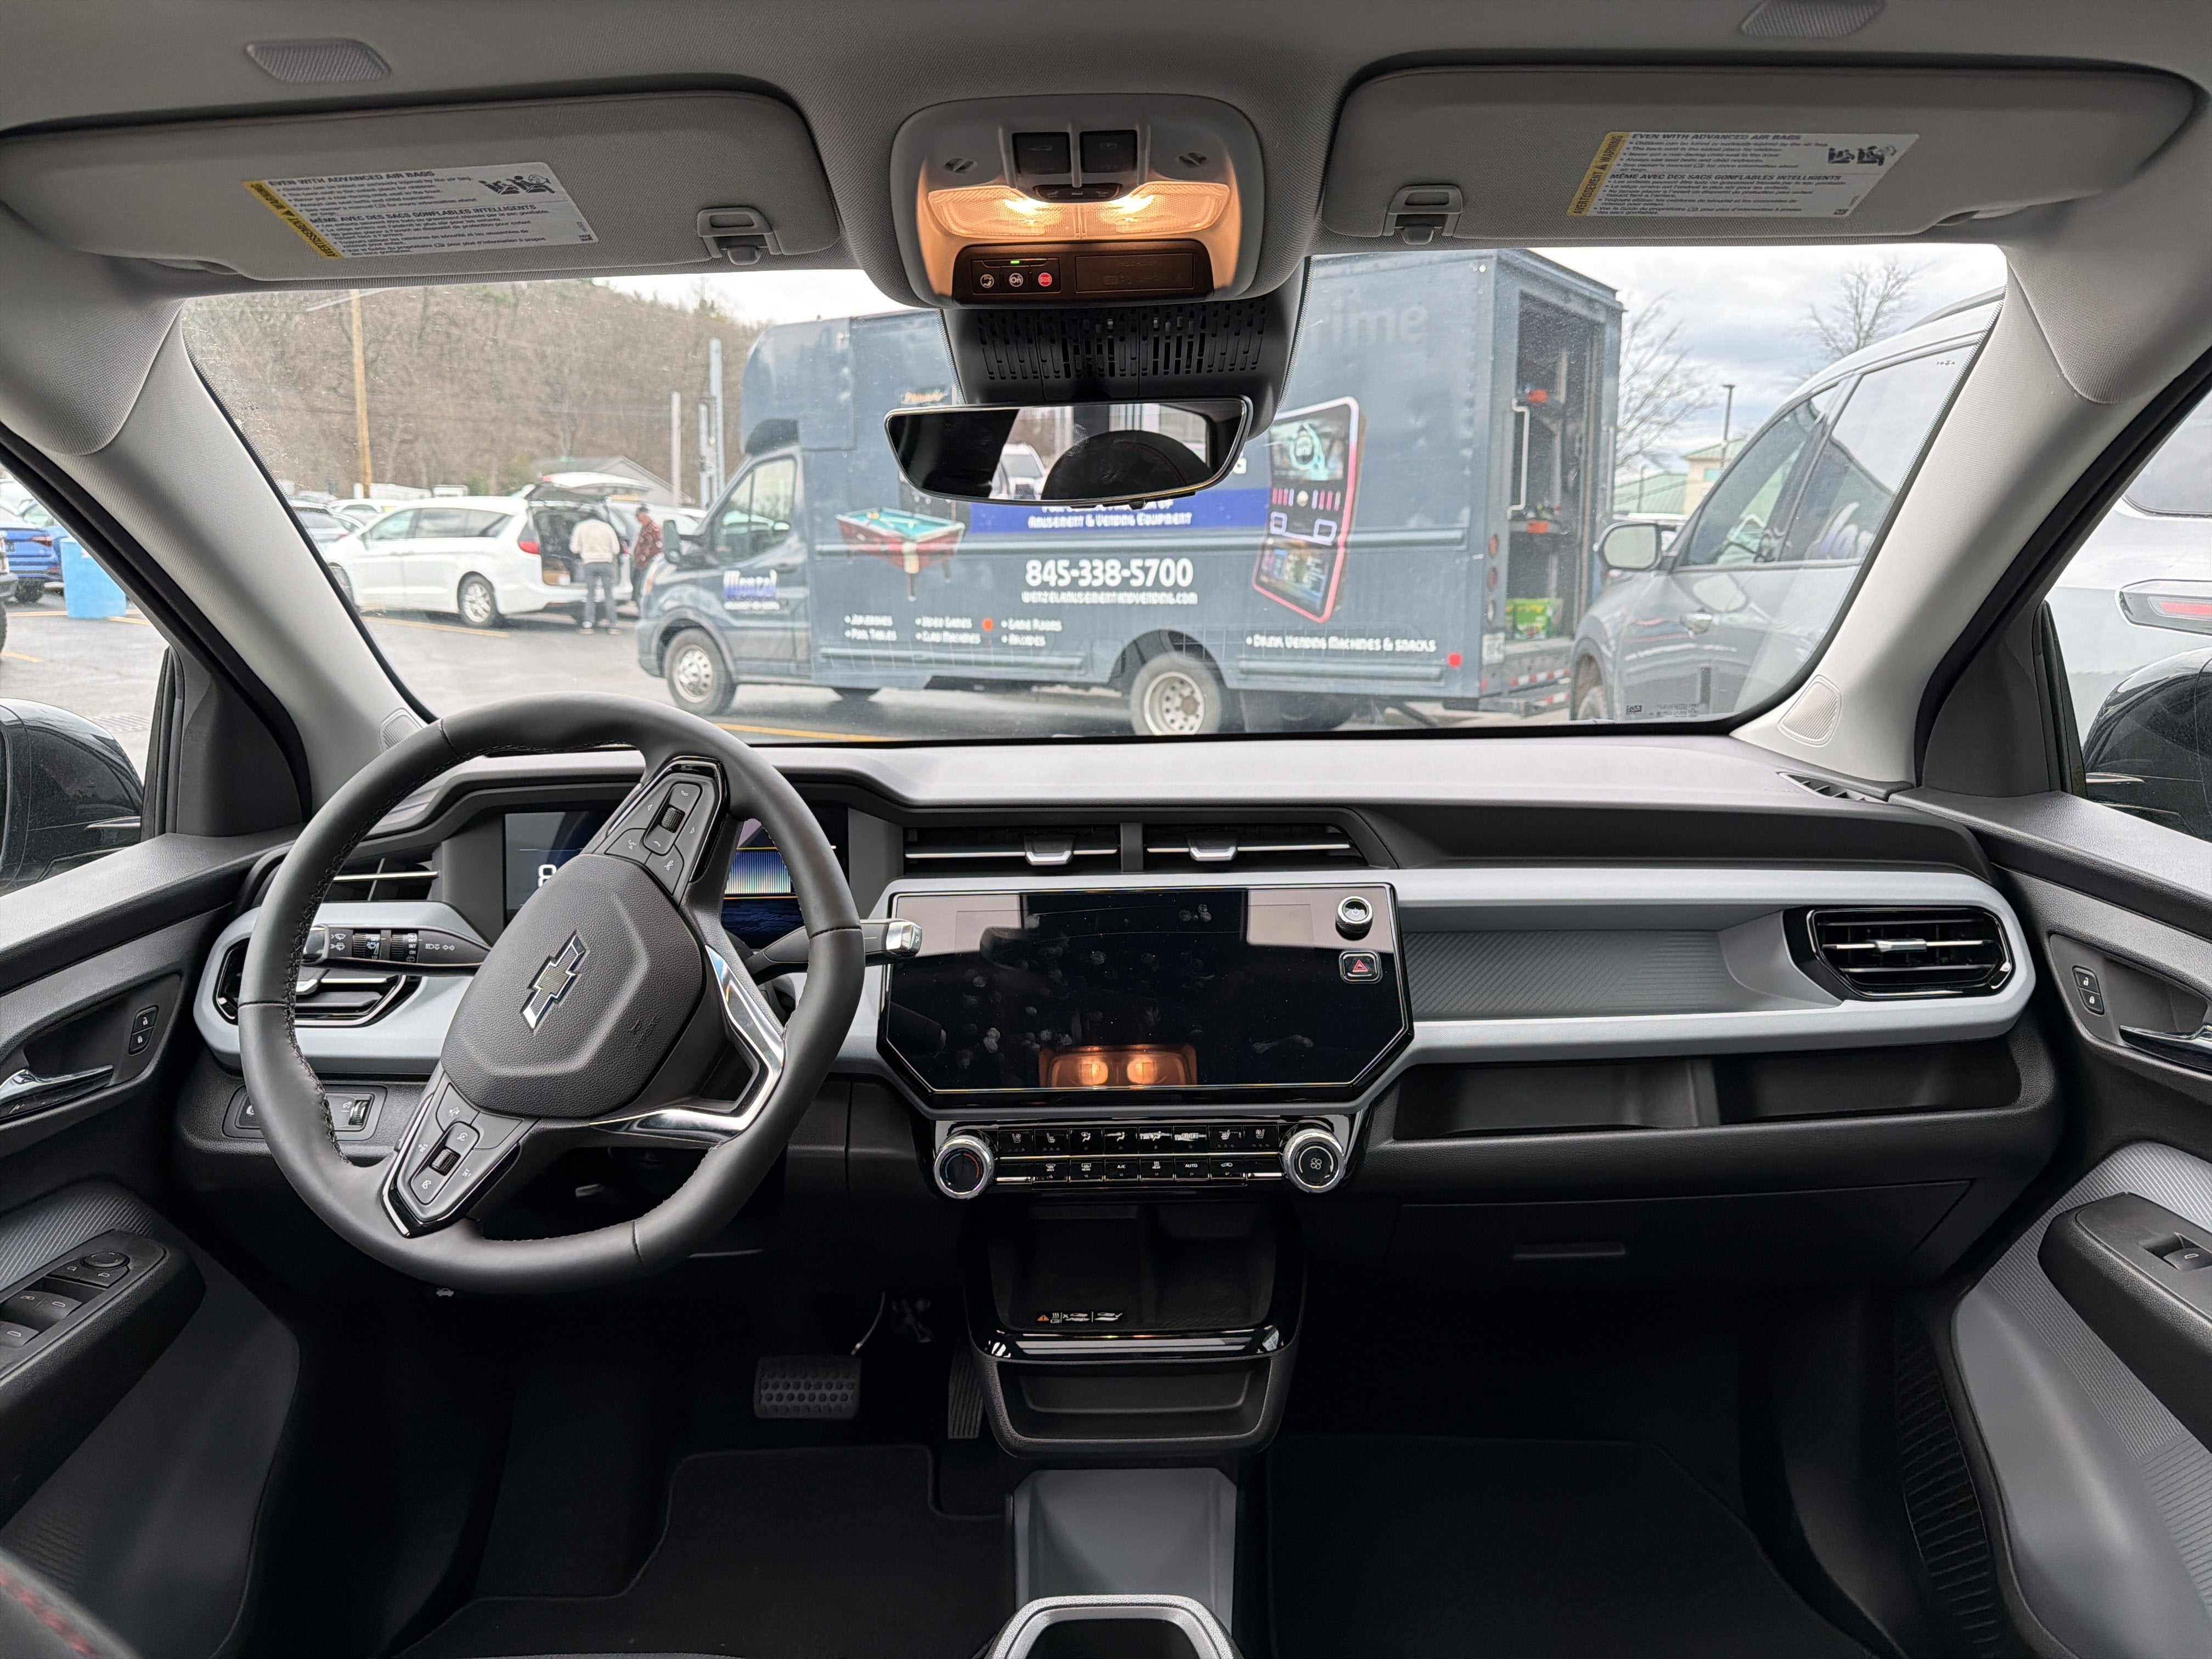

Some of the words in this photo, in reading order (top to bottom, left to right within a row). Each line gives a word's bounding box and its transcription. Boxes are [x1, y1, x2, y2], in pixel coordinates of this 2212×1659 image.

[1085, 514, 1095, 527] &
[1095, 513, 1135, 527] VENDING
[1137, 512, 1193, 526] EQUIPMENT
[1025, 557, 1194, 587] 845-338-5700
[1328, 636, 1381, 651] MACHINES
